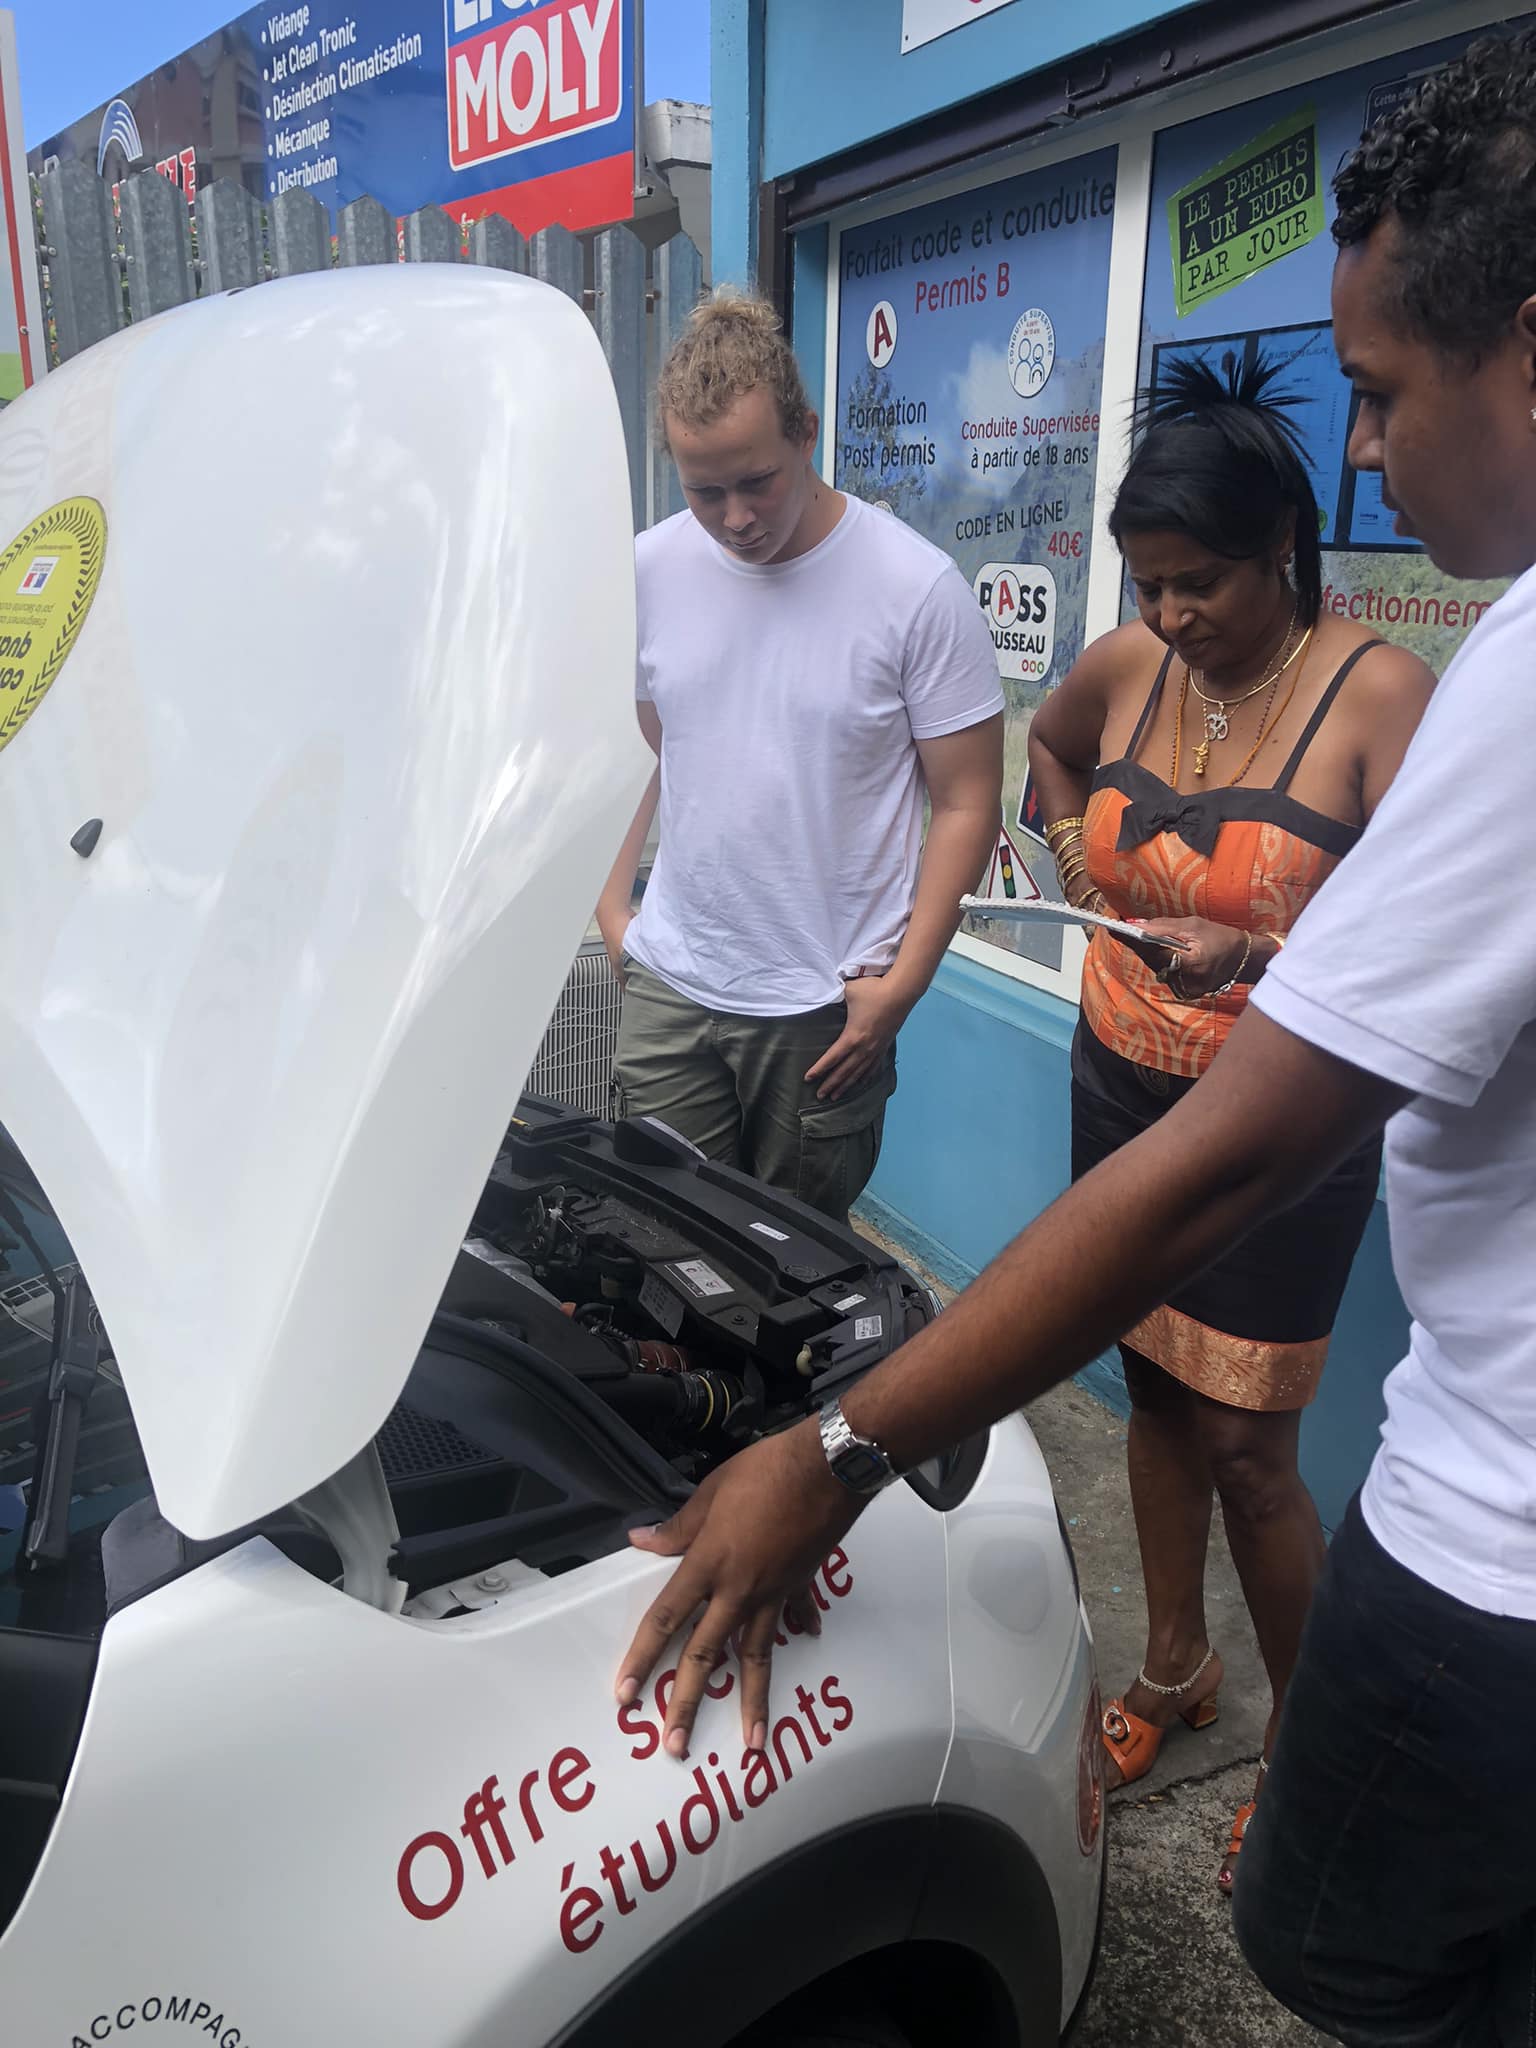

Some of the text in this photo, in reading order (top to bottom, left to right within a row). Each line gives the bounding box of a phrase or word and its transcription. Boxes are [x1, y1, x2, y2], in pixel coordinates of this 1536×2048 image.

[268, 4, 310, 44] Vidange
[271, 17, 357, 83] Jet Clean Tronic
[273, 32, 422, 121] Désinfection Climatisation
[455, 0, 614, 153] MOLY
[275, 118, 330, 159] Mécanique
[277, 154, 338, 194] Distribution
[1184, 137, 1308, 228] LE PERMIS
[846, 177, 1115, 281] Forfait code et conduite
[1186, 173, 1307, 258] A UN EURO
[1187, 210, 1309, 292] PAR JOUR
[915, 262, 1010, 314] Permis B
[873, 308, 893, 359] A
[849, 395, 927, 429] Formation
[961, 408, 1100, 442] Conduite Supervisée
[844, 437, 936, 475] Post permis
[971, 446, 1089, 474] à partir de 18 ans
[956, 500, 1063, 541] CODE EN LIGNE
[1047, 531, 1083, 558] 40€
[980, 580, 1047, 623] PASS
[990, 630, 1046, 654] USSEAU
[396, 1746, 596, 1921] Offre
[559, 1675, 854, 1953] étudiants
[71, 1996, 249, 2048] ACCOMPAG
